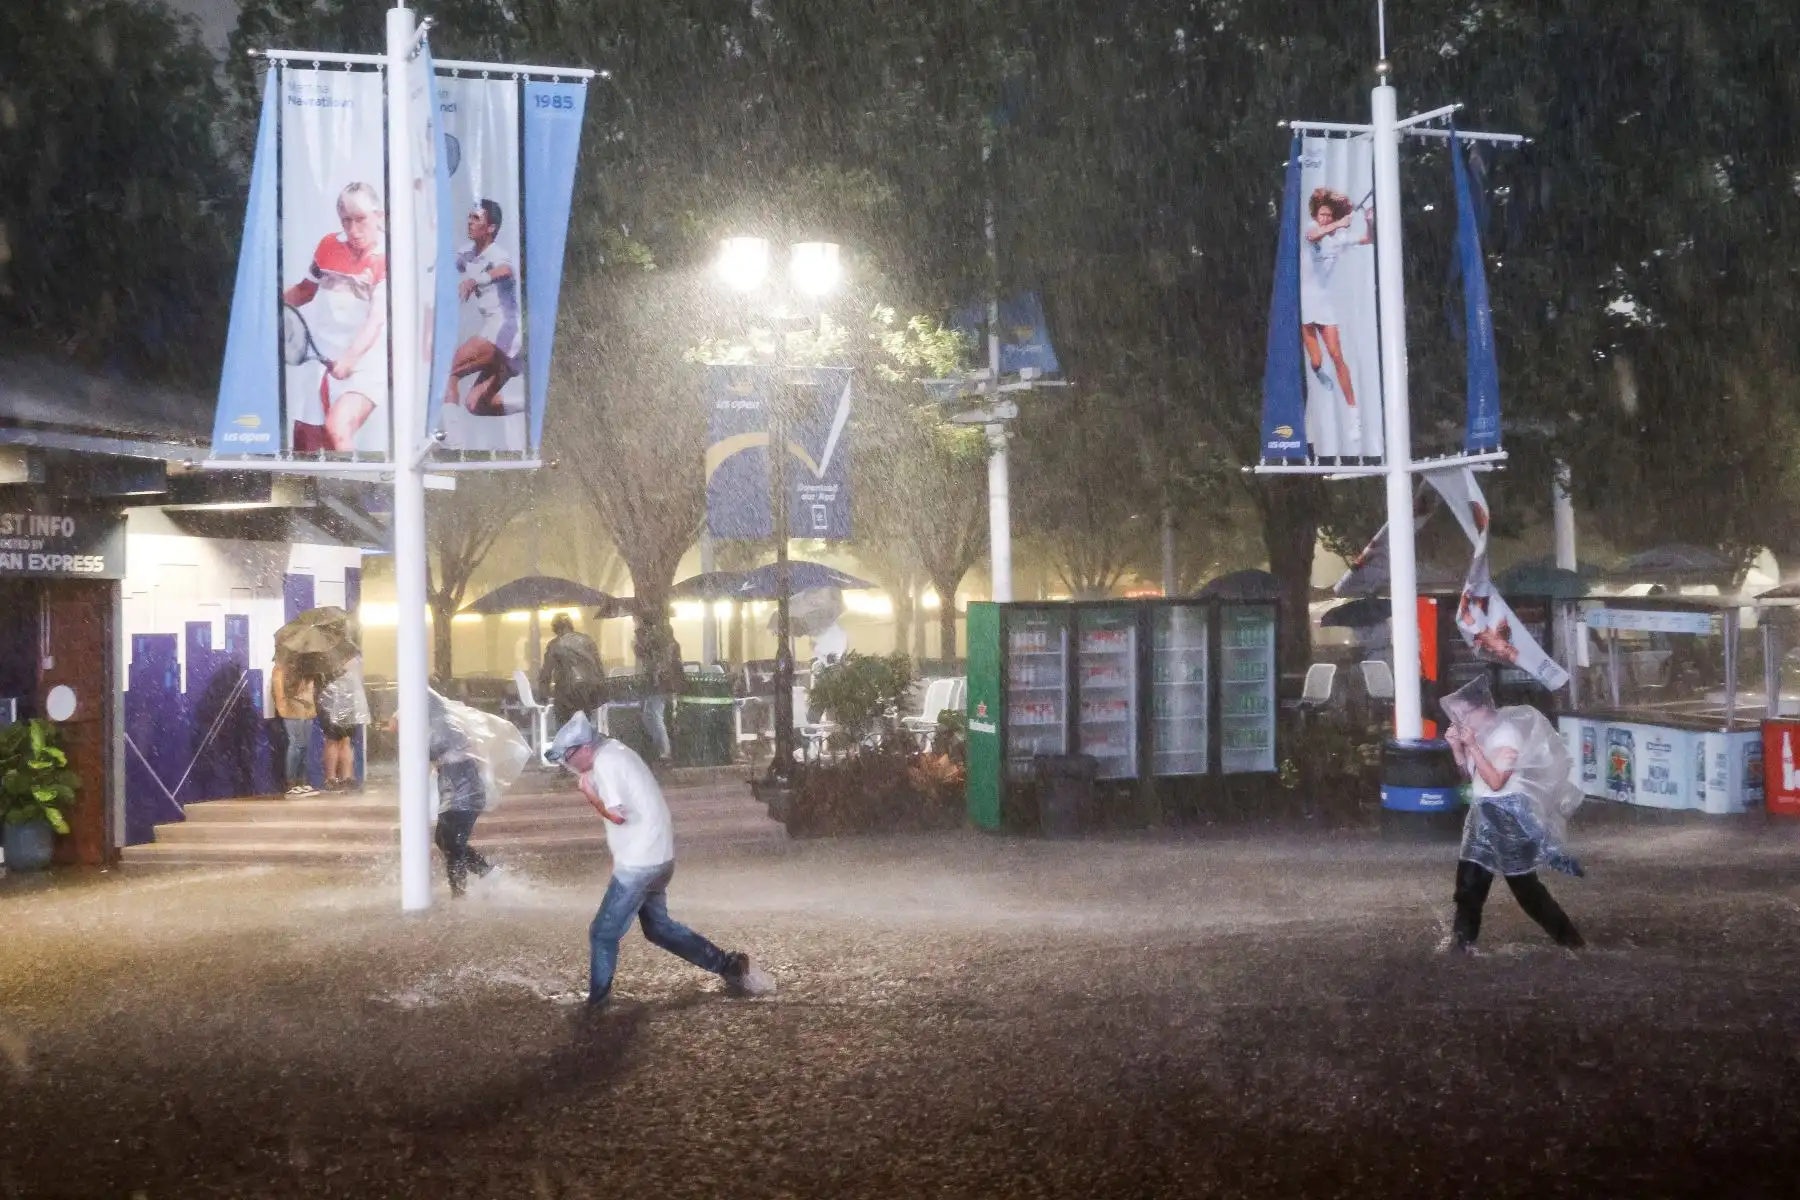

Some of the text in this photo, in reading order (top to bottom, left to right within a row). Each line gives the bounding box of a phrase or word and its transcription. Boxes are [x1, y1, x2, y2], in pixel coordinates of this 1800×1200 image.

[534, 94, 575, 109] 1985
[29, 515, 75, 537] INFO
[28, 554, 104, 572] EXPRESS
